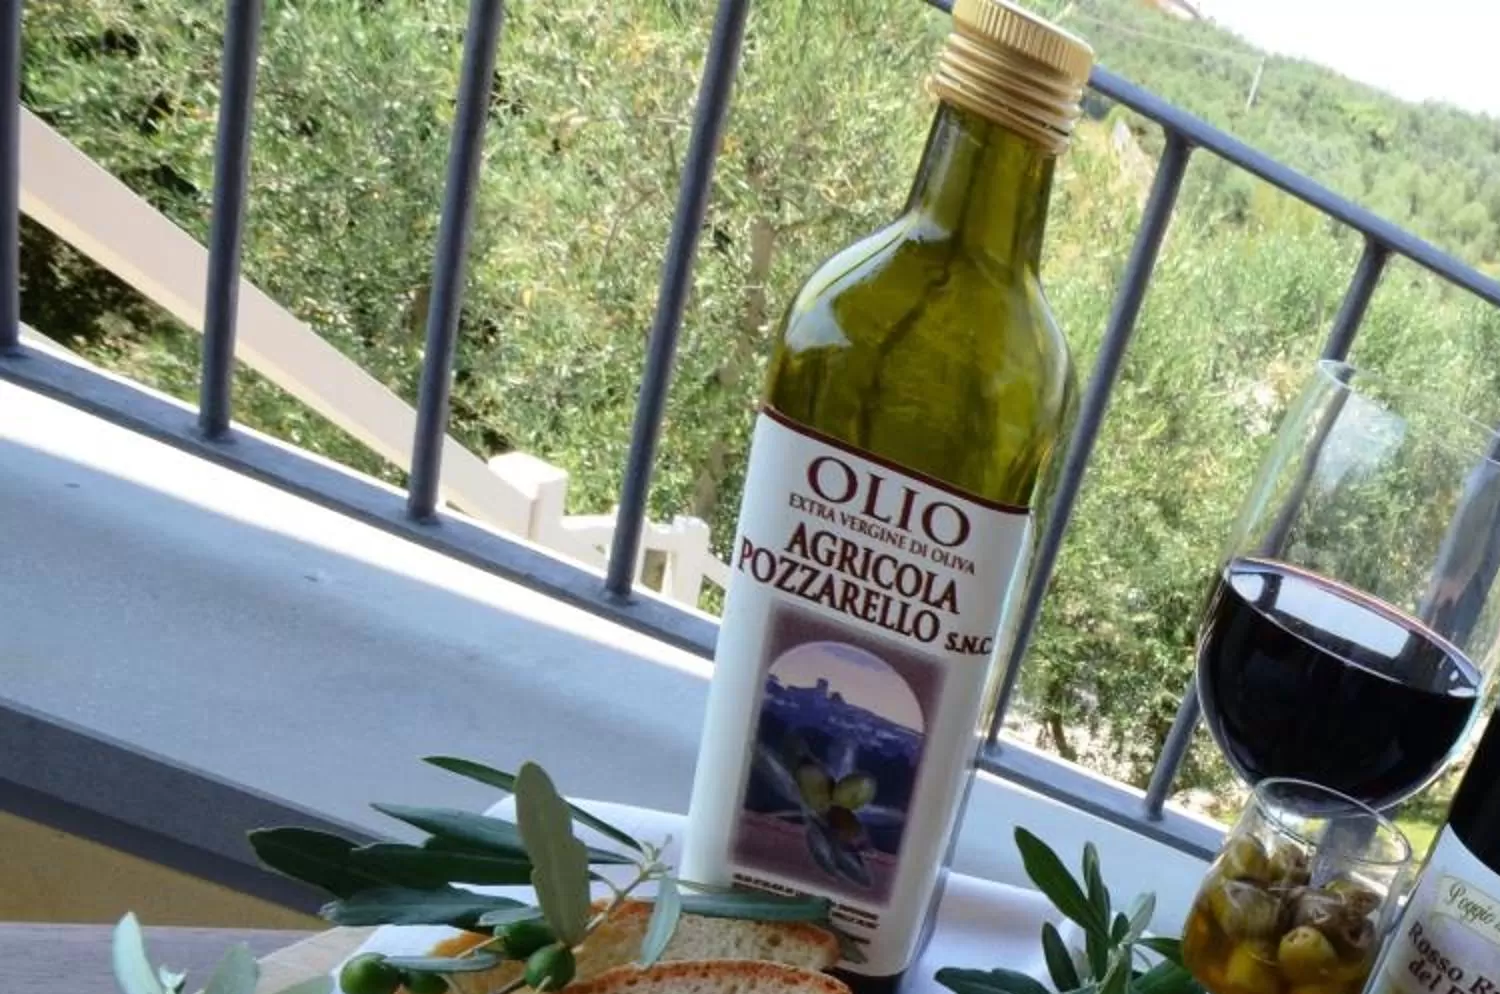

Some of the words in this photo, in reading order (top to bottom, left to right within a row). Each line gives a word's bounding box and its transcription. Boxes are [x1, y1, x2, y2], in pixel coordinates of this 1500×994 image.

[788, 492, 836, 522] EXTRA
[839, 512, 907, 550] VERGINE
[909, 540, 927, 558] DI
[930, 548, 976, 576] OLIVA
[807, 455, 971, 548] OLIO
[738, 536, 940, 643] POZZARELLO
[784, 521, 961, 615] AGRICOLA
[1408, 920, 1463, 982] Rosso
[1408, 959, 1442, 992] del
